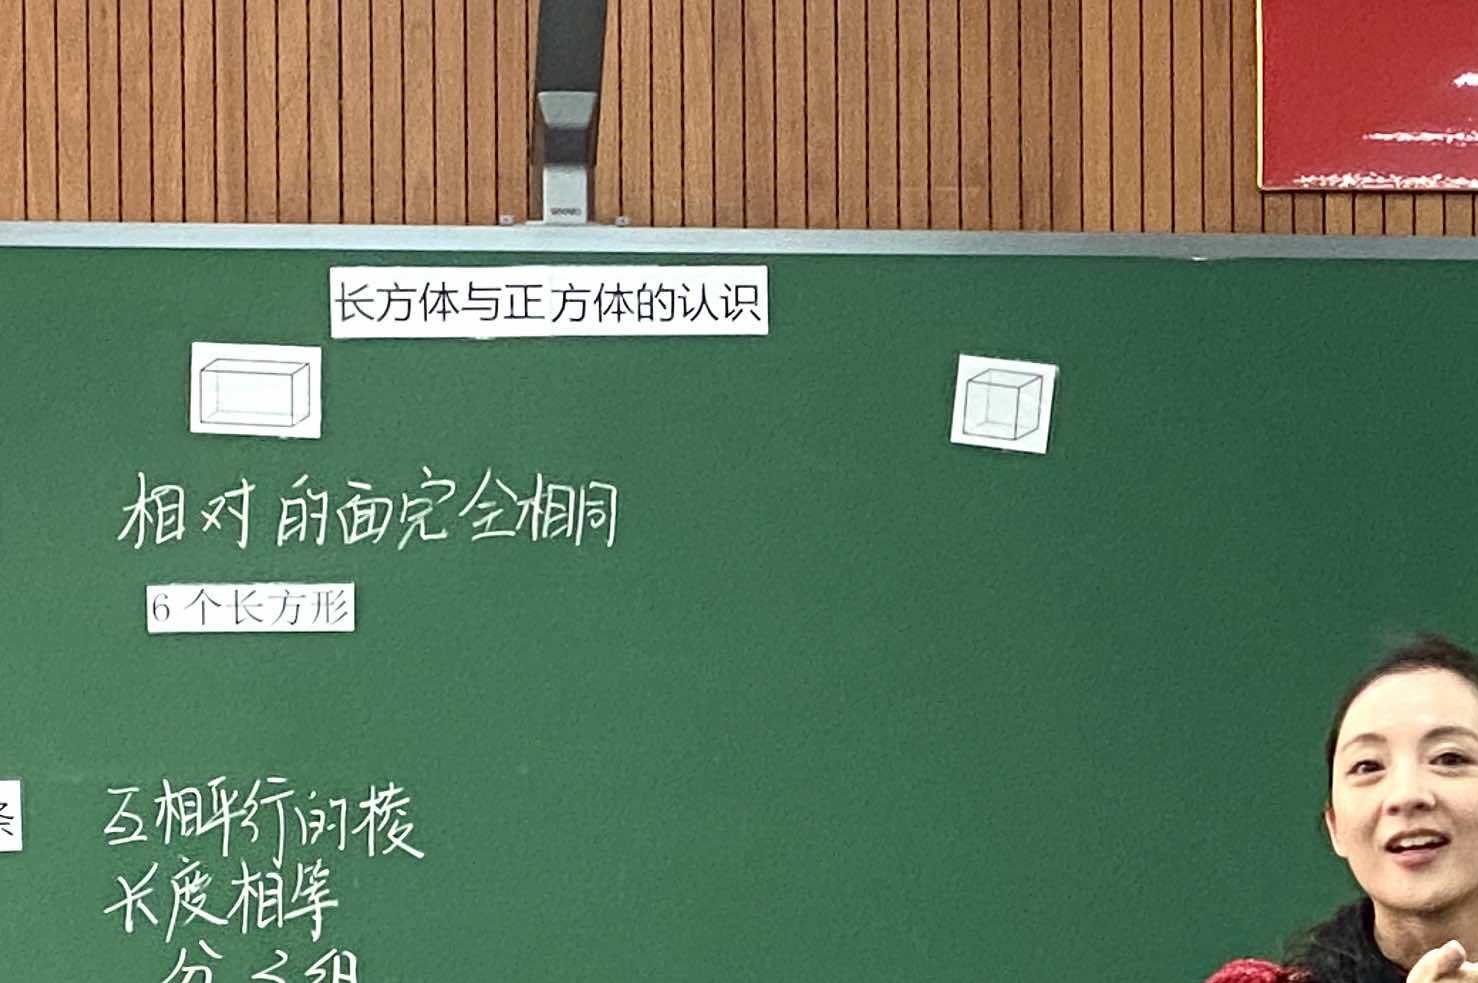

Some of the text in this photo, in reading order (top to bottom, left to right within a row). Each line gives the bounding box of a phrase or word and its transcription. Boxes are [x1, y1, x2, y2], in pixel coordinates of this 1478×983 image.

[334, 281, 761, 323] 长方体与正方体的认识
[117, 466, 618, 549] 相对的面完全相同
[103, 776, 425, 868] 互相平行的棱
[103, 856, 339, 942] 长度相等
